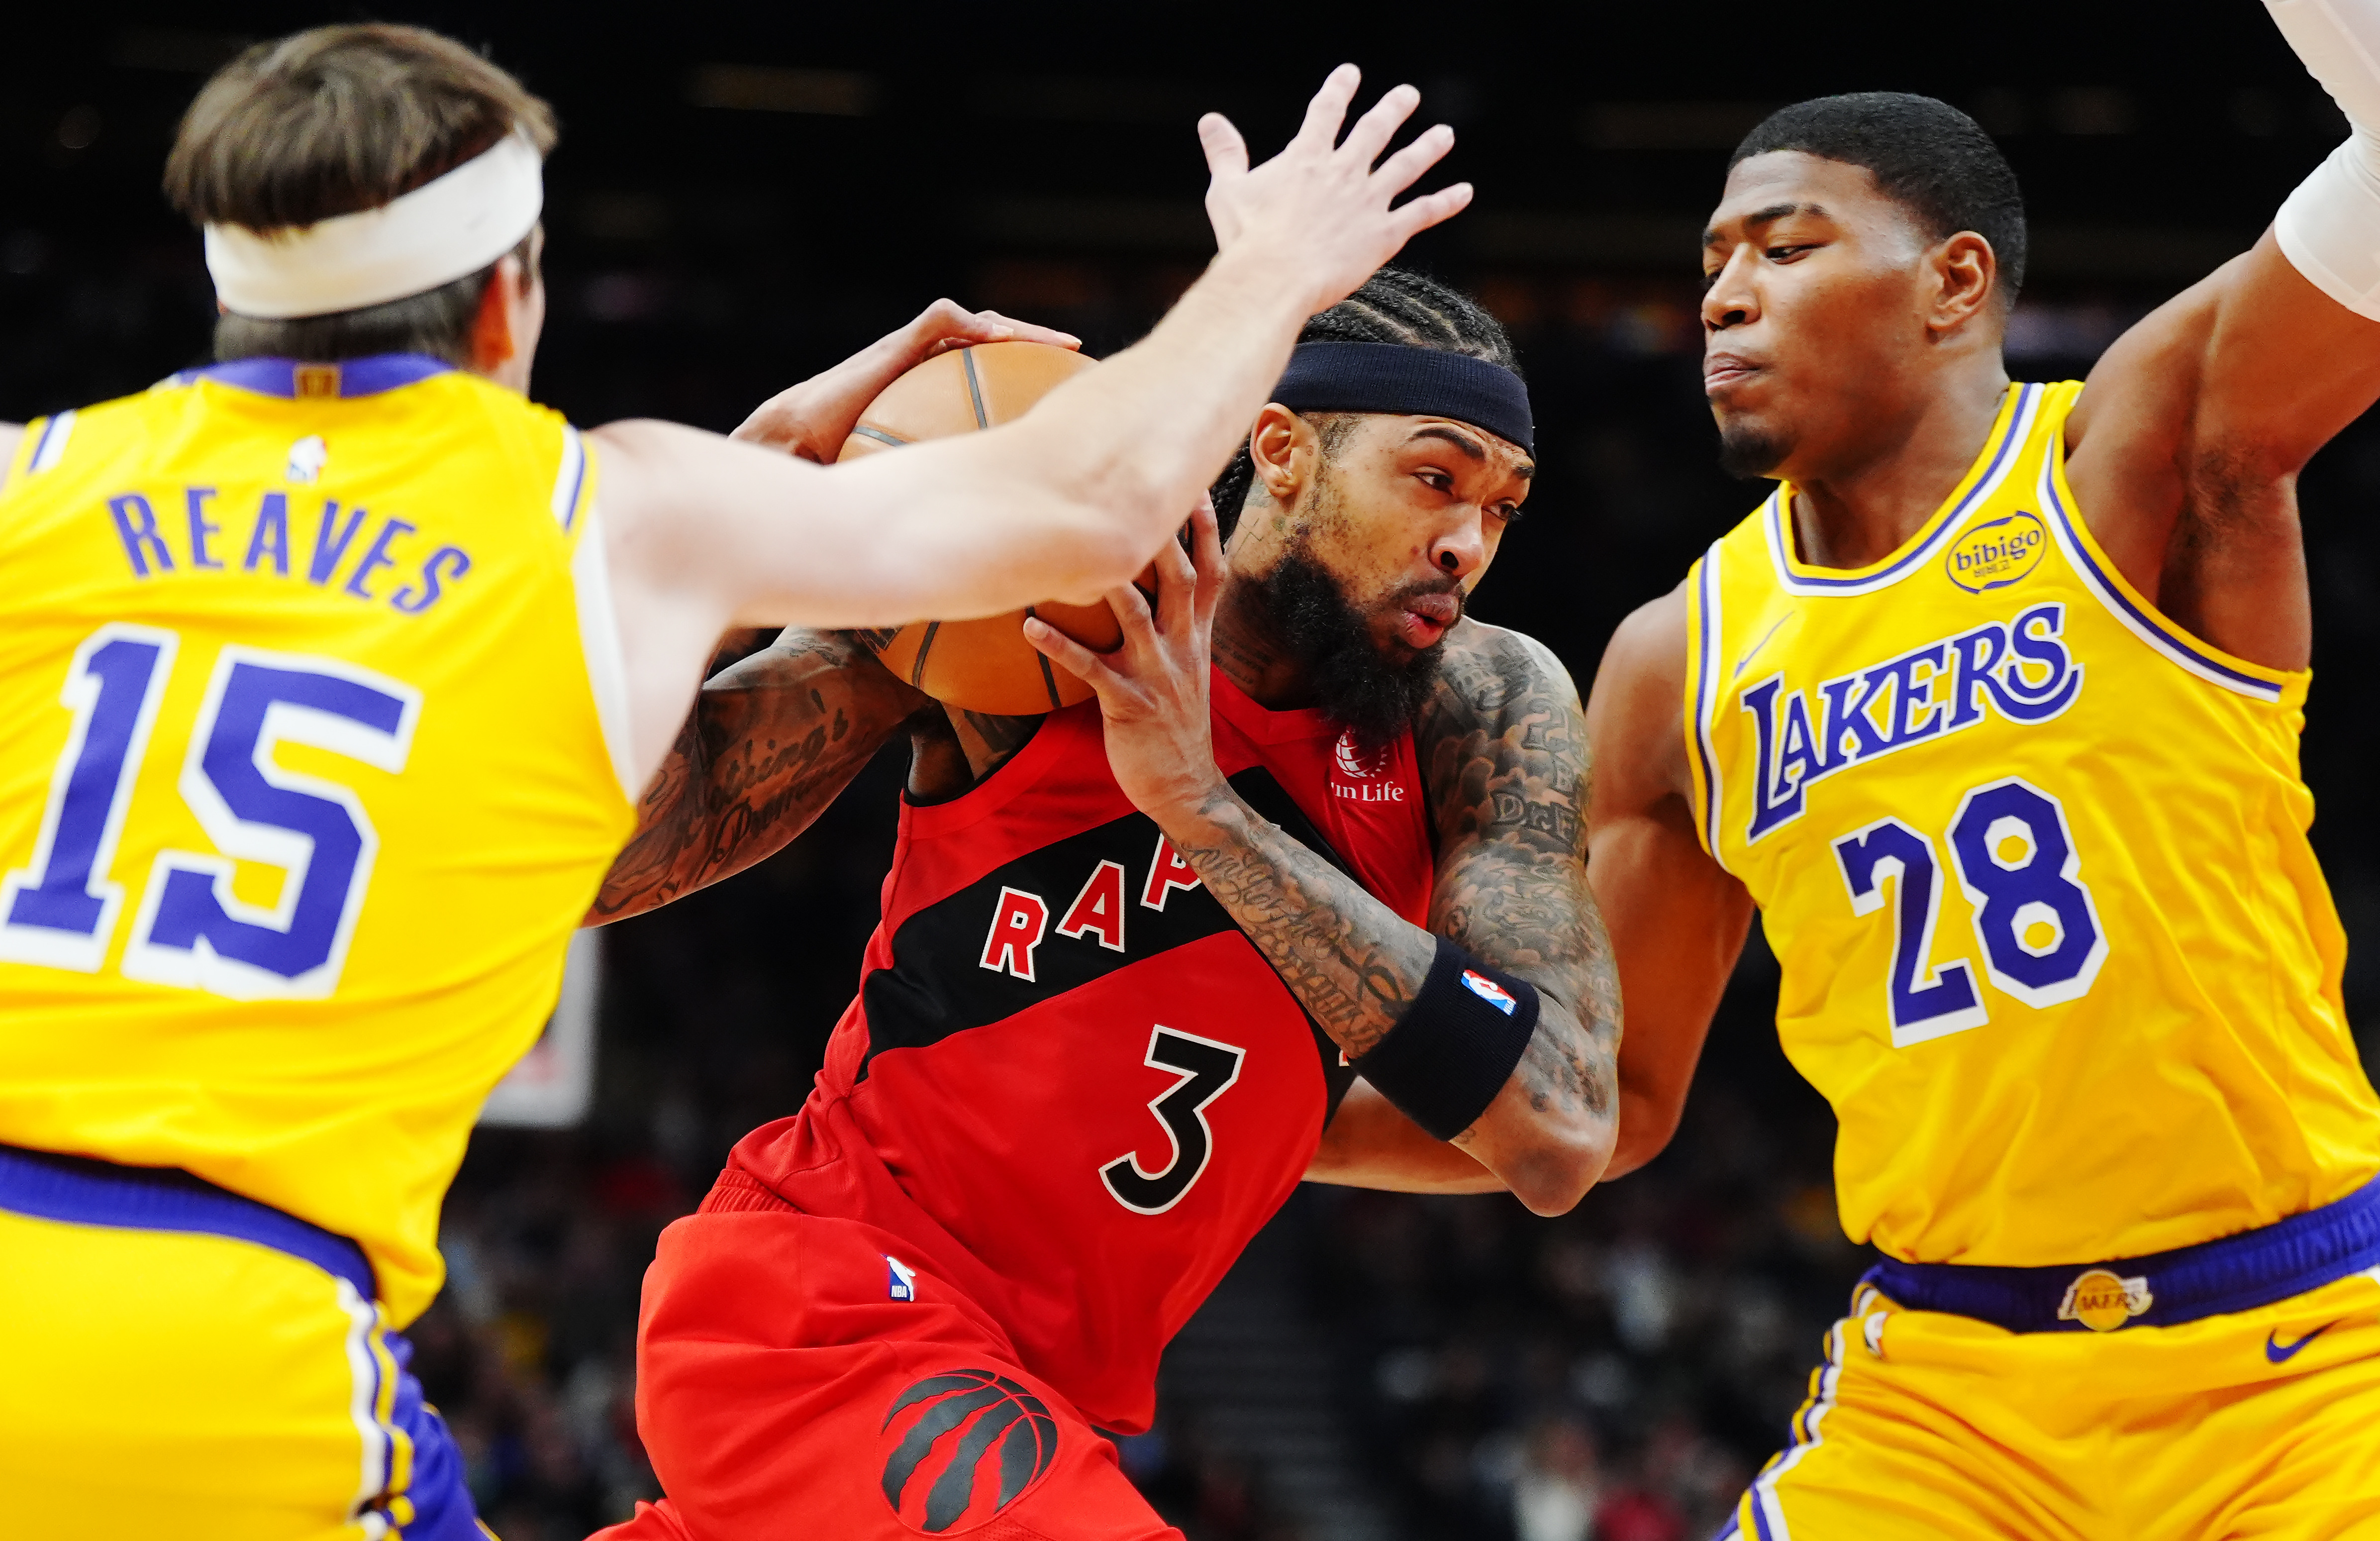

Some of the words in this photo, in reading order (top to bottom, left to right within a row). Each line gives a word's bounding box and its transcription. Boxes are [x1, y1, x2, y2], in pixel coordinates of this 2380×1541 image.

[107, 486, 471, 614] REAVES
[1956, 530, 2040, 570] bibigo
[1362, 781, 1404, 802] Life
[1740, 601, 2085, 844] LAKERS
[0, 621, 423, 1002] 15
[1830, 775, 2109, 1048] 28
[1098, 1024, 1246, 1215] 3
[891, 1285, 907, 1298] NBA
